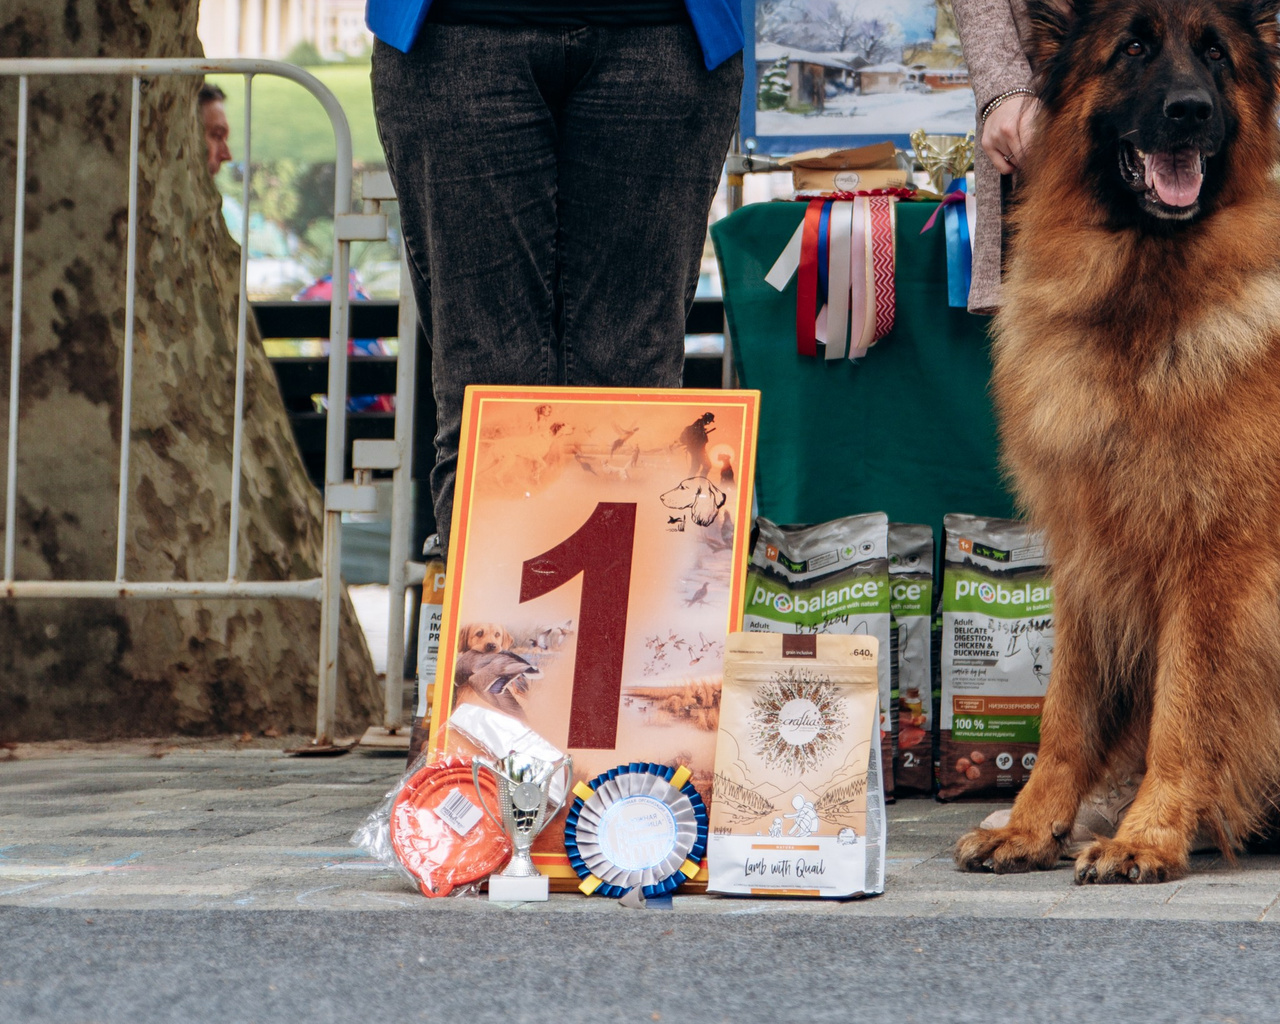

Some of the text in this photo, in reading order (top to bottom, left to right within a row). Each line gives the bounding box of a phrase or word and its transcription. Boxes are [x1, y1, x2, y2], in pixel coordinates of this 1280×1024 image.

[751, 580, 880, 614] probalance
[860, 600, 879, 608] nature
[518, 501, 638, 750] 1
[750, 621, 770, 630] Adult
[953, 618, 973, 627] Adult
[954, 627, 988, 635] DELICATE
[954, 635, 994, 643] DIGESTION
[953, 642, 993, 650] CHICKEN &
[953, 649, 1000, 658] BUCKWHEAT
[954, 718, 985, 730] 100 %
[744, 857, 827, 879] Lamb with Quail
